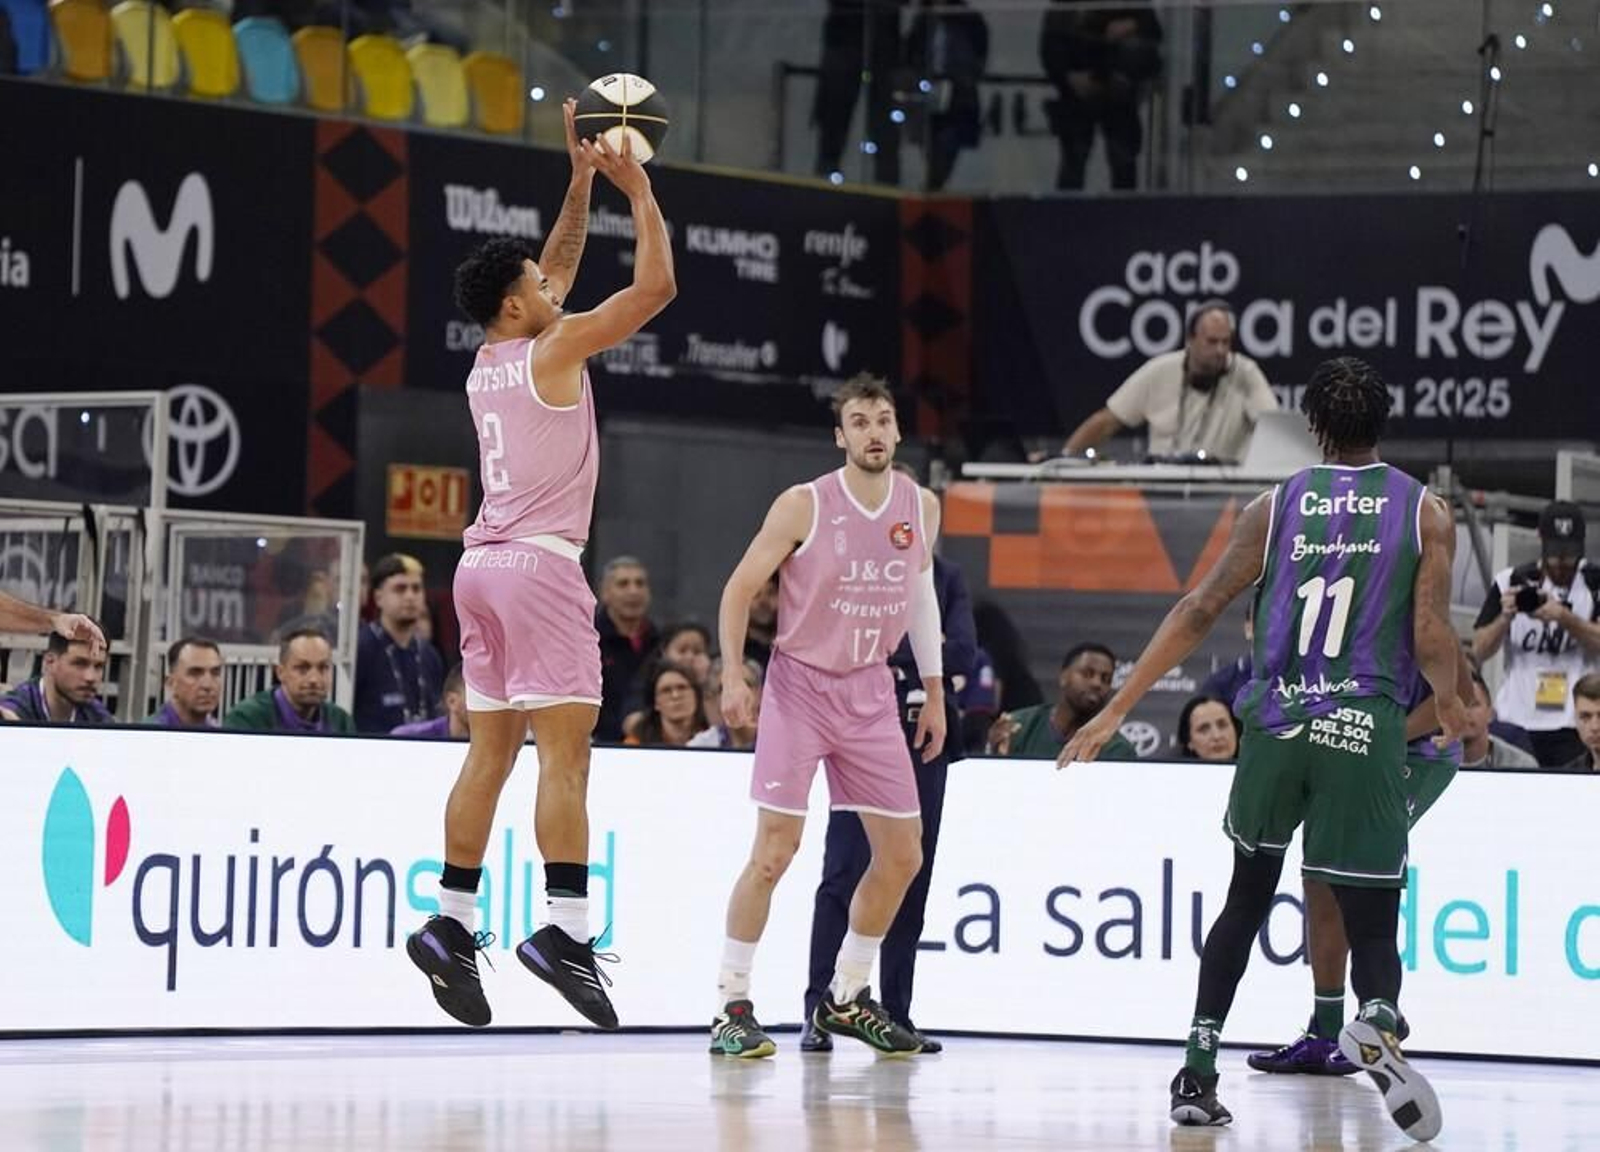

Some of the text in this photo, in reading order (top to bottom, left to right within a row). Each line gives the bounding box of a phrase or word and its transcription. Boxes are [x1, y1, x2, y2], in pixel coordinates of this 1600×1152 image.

[444, 184, 541, 240] Wilson
[0, 236, 30, 287] ia
[686, 225, 779, 260] KUMHO
[803, 223, 869, 268] renfe
[733, 259, 779, 282] TIRE
[1125, 241, 1240, 295] acb
[1308, 298, 1397, 348] del
[1416, 286, 1566, 373] Rey
[1413, 377, 1511, 419] 2025
[481, 412, 512, 493] 2
[1300, 489, 1389, 516] Carter
[839, 560, 906, 583] J&C
[1296, 576, 1355, 658] 11
[852, 626, 881, 664] 17
[1310, 718, 1372, 743] DEL SOL
[916, 883, 1001, 954] a
